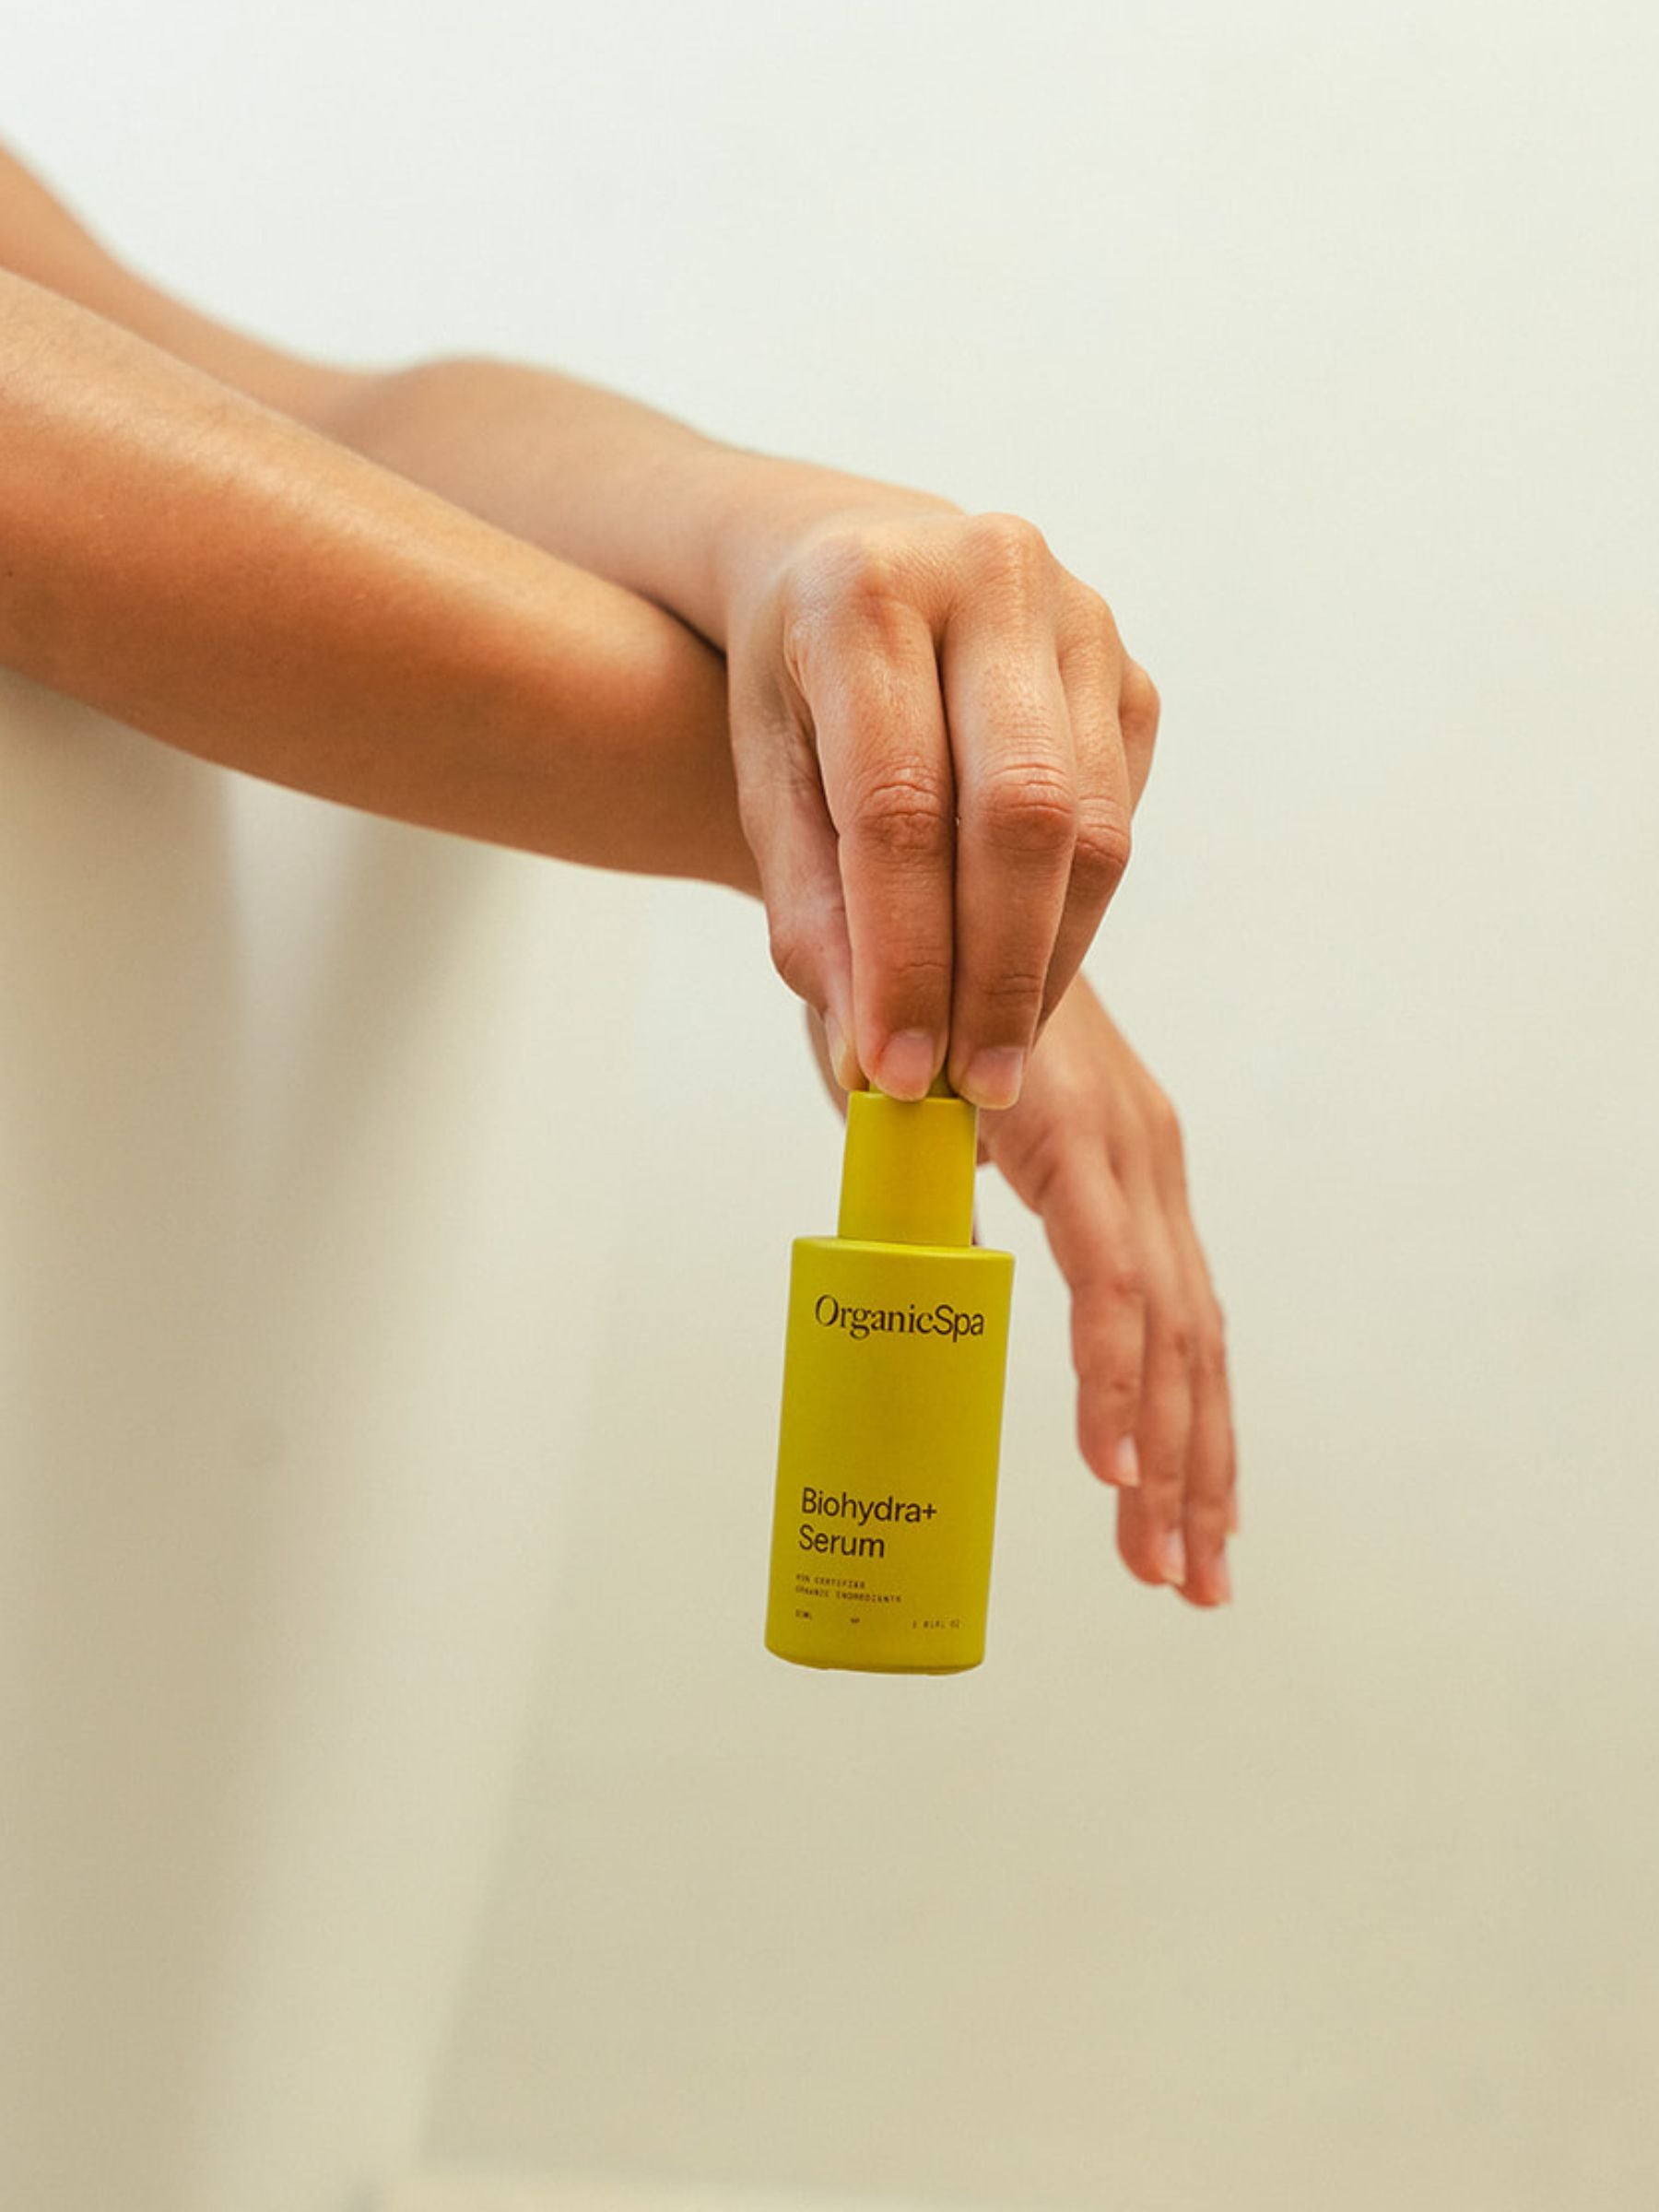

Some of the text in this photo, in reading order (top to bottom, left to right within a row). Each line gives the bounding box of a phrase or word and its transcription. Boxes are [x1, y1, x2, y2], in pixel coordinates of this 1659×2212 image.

[816, 1294, 984, 1343] OrganicSpa
[802, 1487, 937, 1526] Biohydra+
[799, 1524, 885, 1559] Serum
